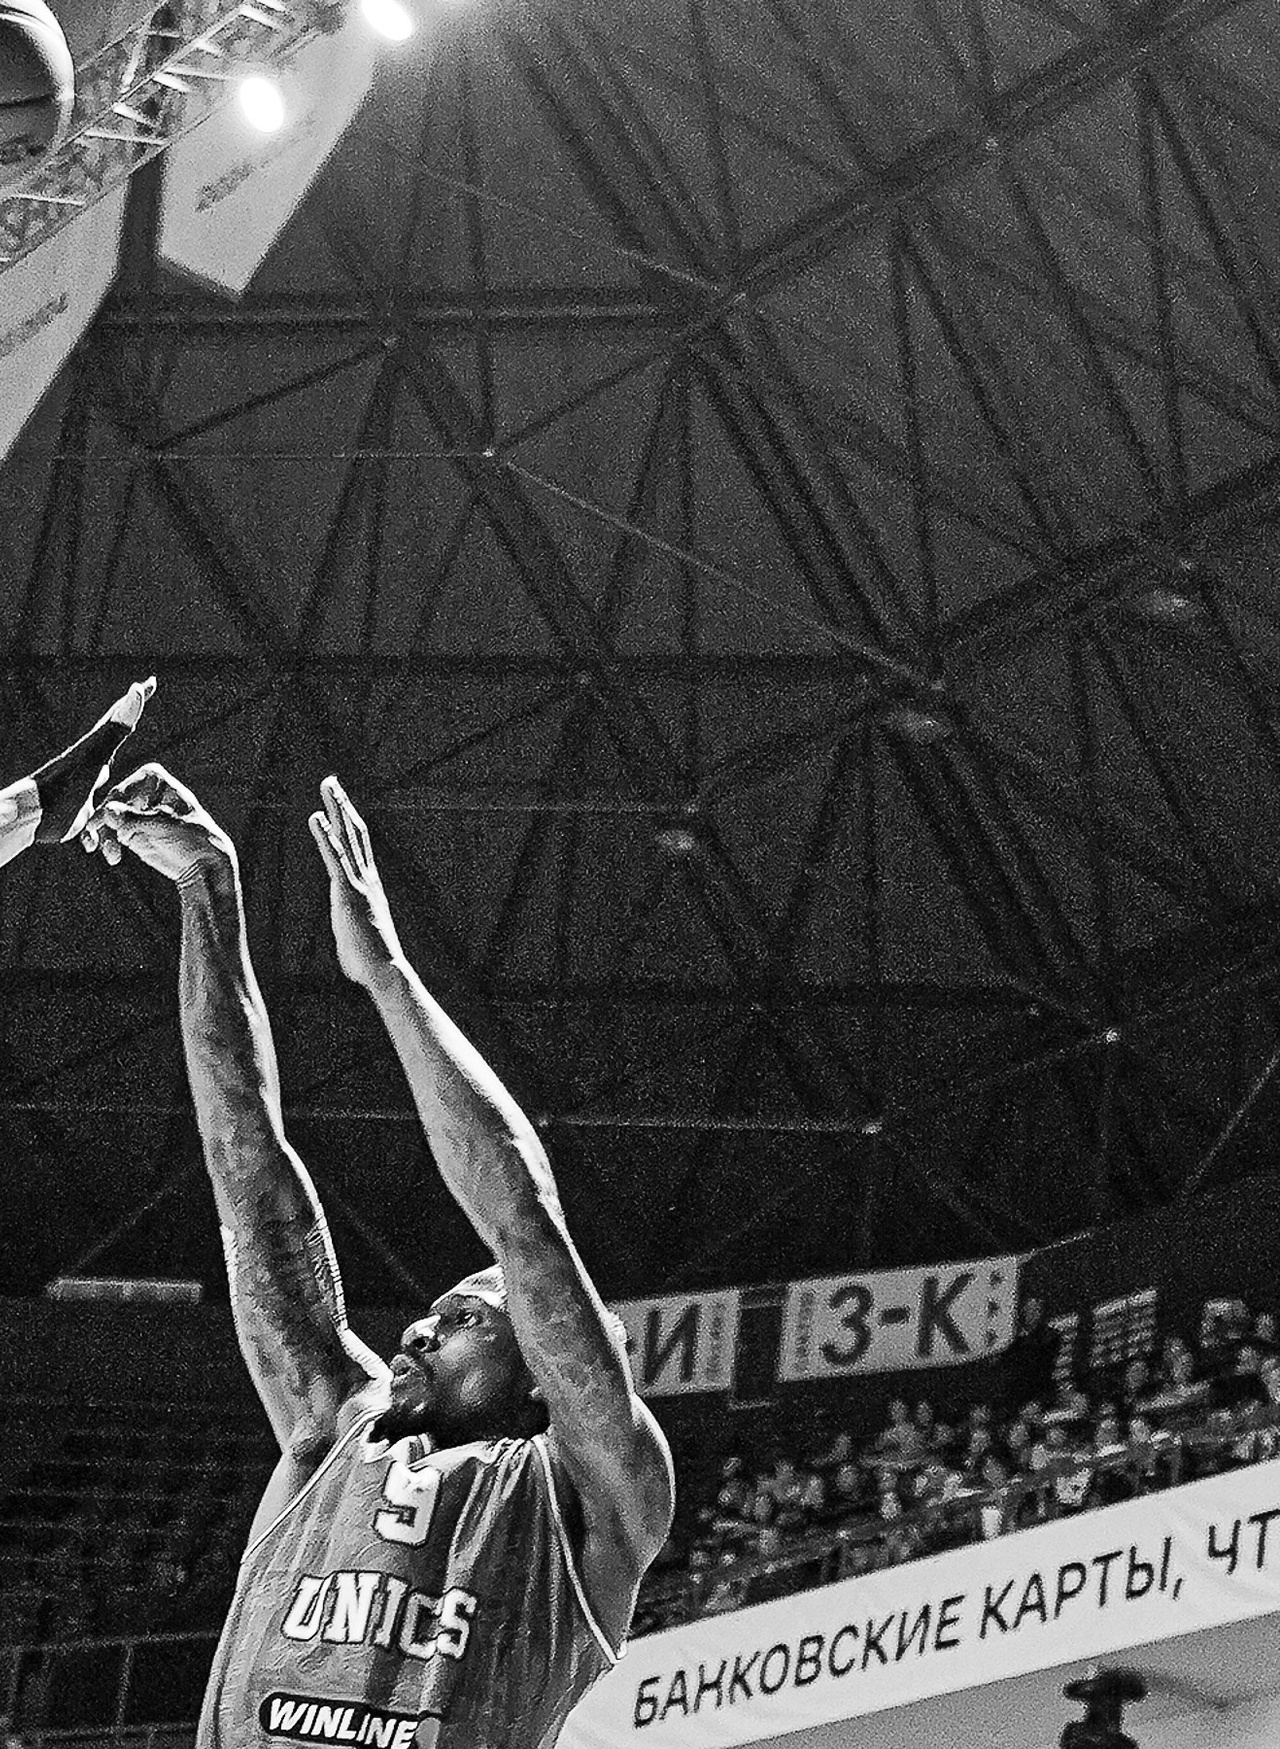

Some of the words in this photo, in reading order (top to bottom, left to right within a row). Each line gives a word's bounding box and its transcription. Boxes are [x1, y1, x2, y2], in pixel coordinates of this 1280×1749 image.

[372, 1459, 441, 1547] 9
[281, 1569, 478, 1661] UNICS
[633, 1594, 966, 1729] БАНКОВСКИЕ
[979, 1535, 1184, 1641] КАРТЫ,
